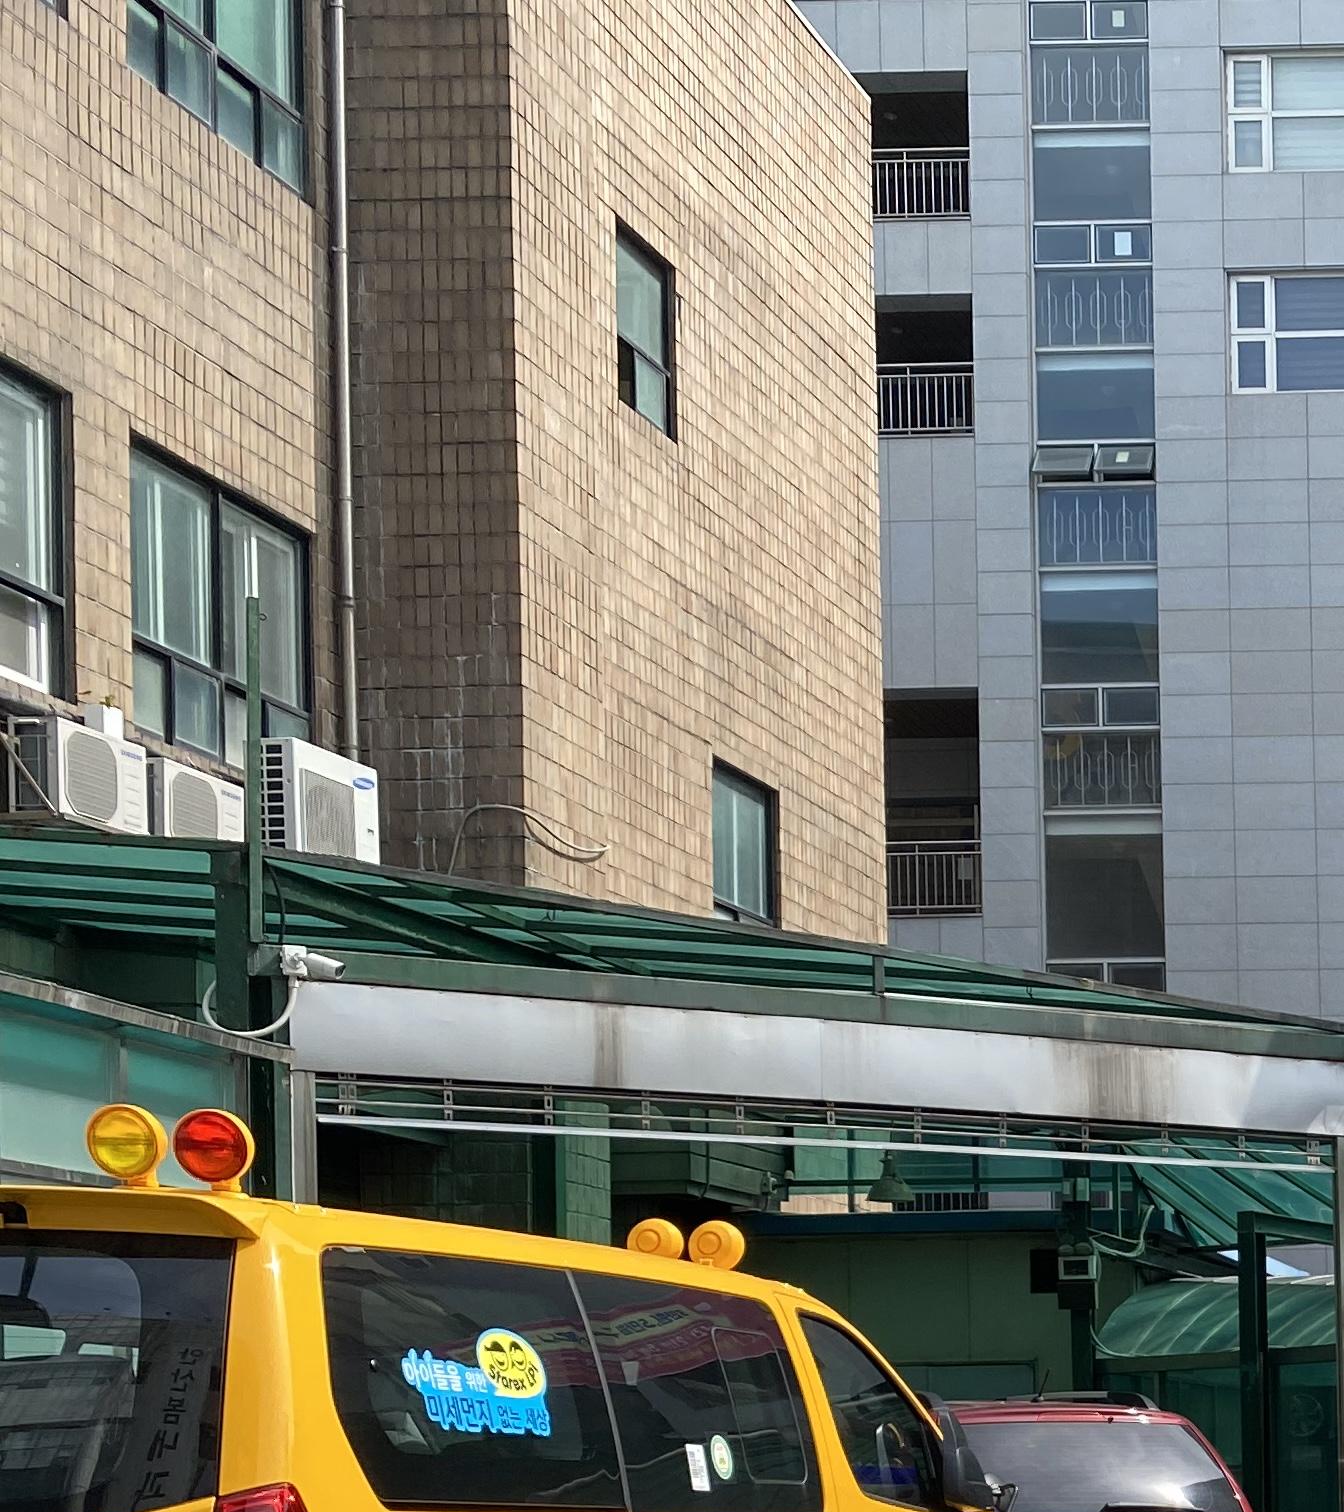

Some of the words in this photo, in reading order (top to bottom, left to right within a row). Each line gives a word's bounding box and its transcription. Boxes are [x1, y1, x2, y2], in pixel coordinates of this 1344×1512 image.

[402, 1349, 463, 1392] 아이들을
[464, 1369, 488, 1393] 위한
[426, 1394, 497, 1430] 미세먼지
[497, 1405, 522, 1430] 없는
[525, 1408, 548, 1432] 세상
